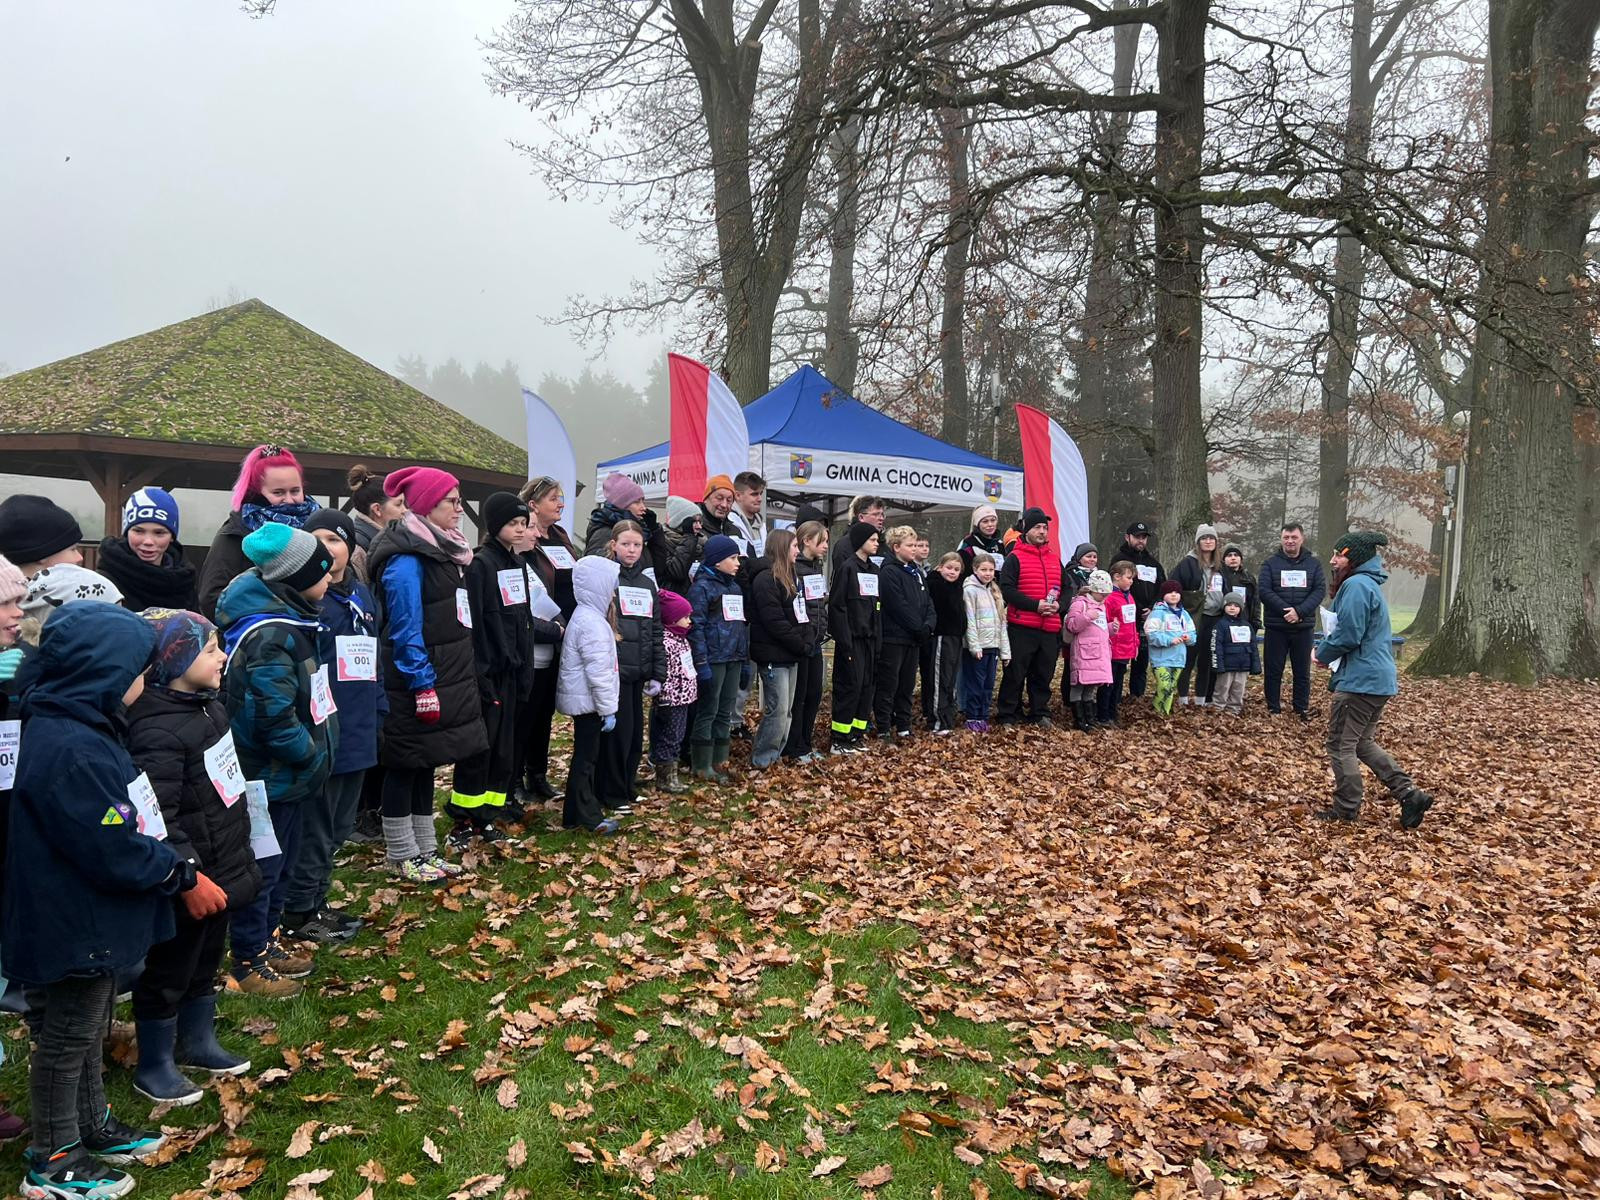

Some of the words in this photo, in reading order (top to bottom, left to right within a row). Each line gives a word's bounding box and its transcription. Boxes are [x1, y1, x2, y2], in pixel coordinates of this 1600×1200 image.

[826, 463, 882, 483] GMINA
[887, 469, 973, 493] CHOCZEWO
[354, 656, 371, 665] 001
